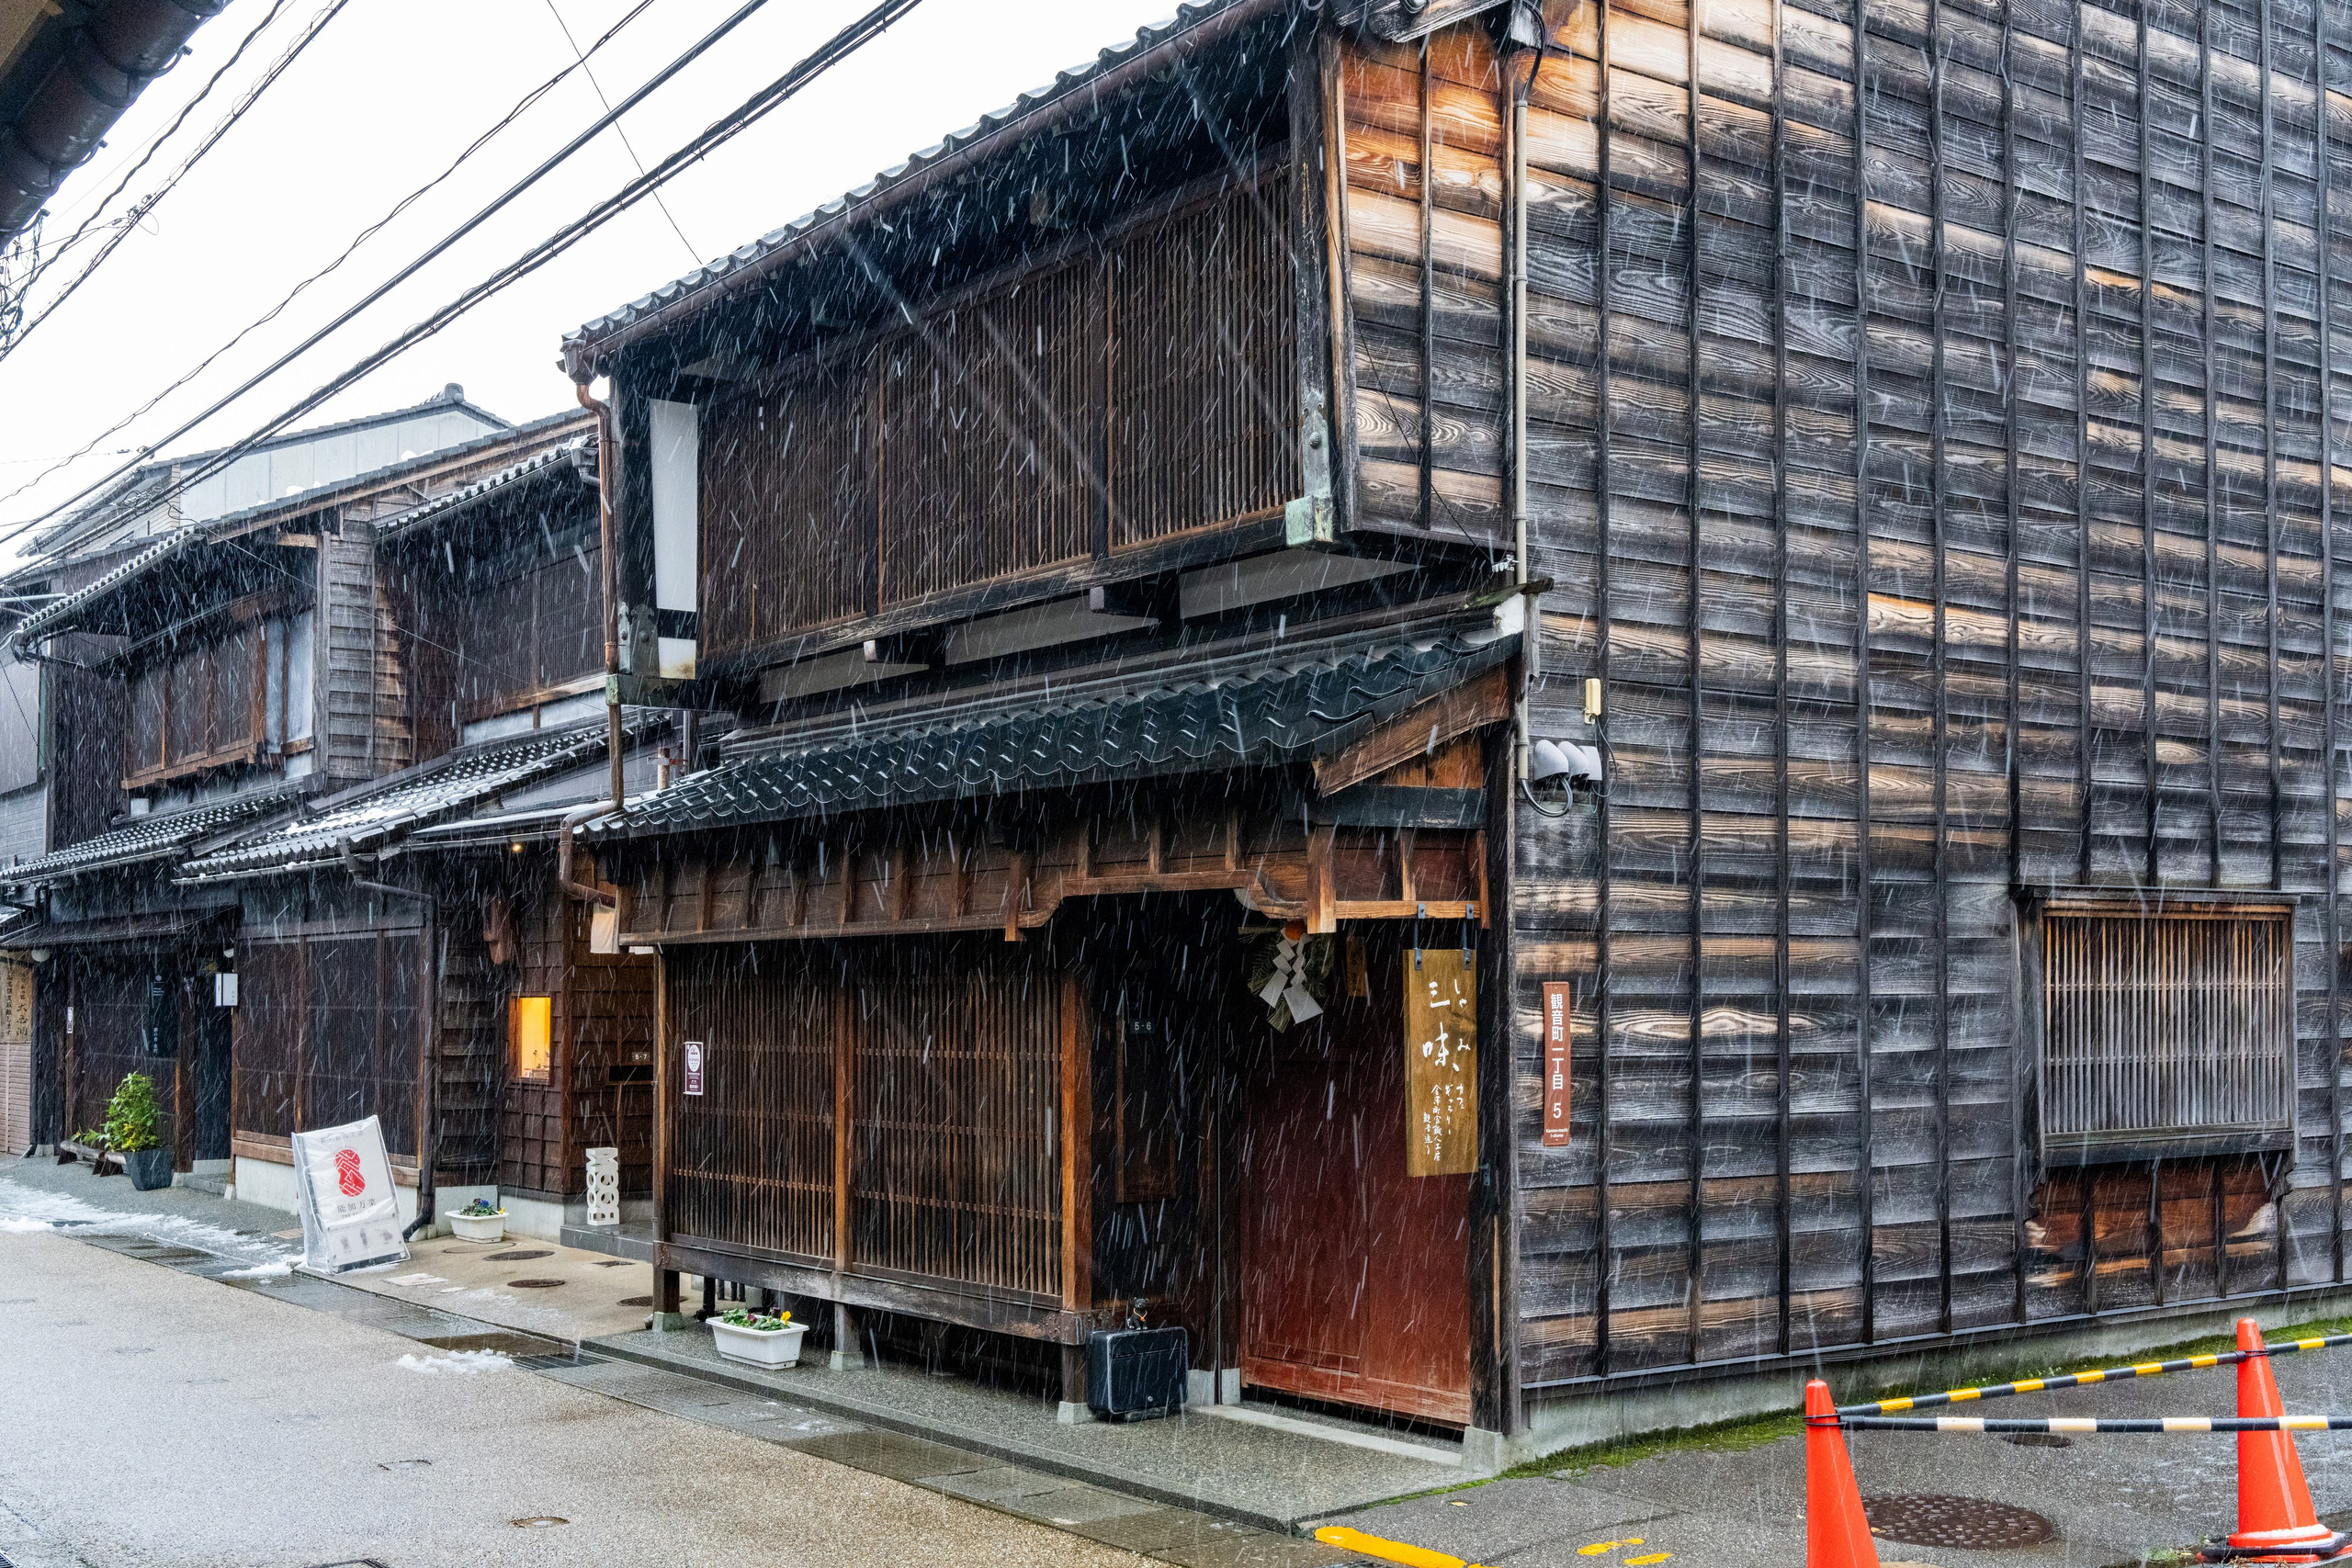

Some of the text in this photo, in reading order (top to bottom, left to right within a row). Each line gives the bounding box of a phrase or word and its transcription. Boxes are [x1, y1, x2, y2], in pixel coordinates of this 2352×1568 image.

[1134, 1021, 1152, 1031] 5-6
[1421, 981, 1460, 1072] 三味
[1550, 993, 1565, 1119] 観音町一丁目 5
[1444, 1084, 1454, 1135] ぎゃらりー
[1456, 1083, 1465, 1110] カフェ
[337, 1198, 377, 1213] 能加万菜
